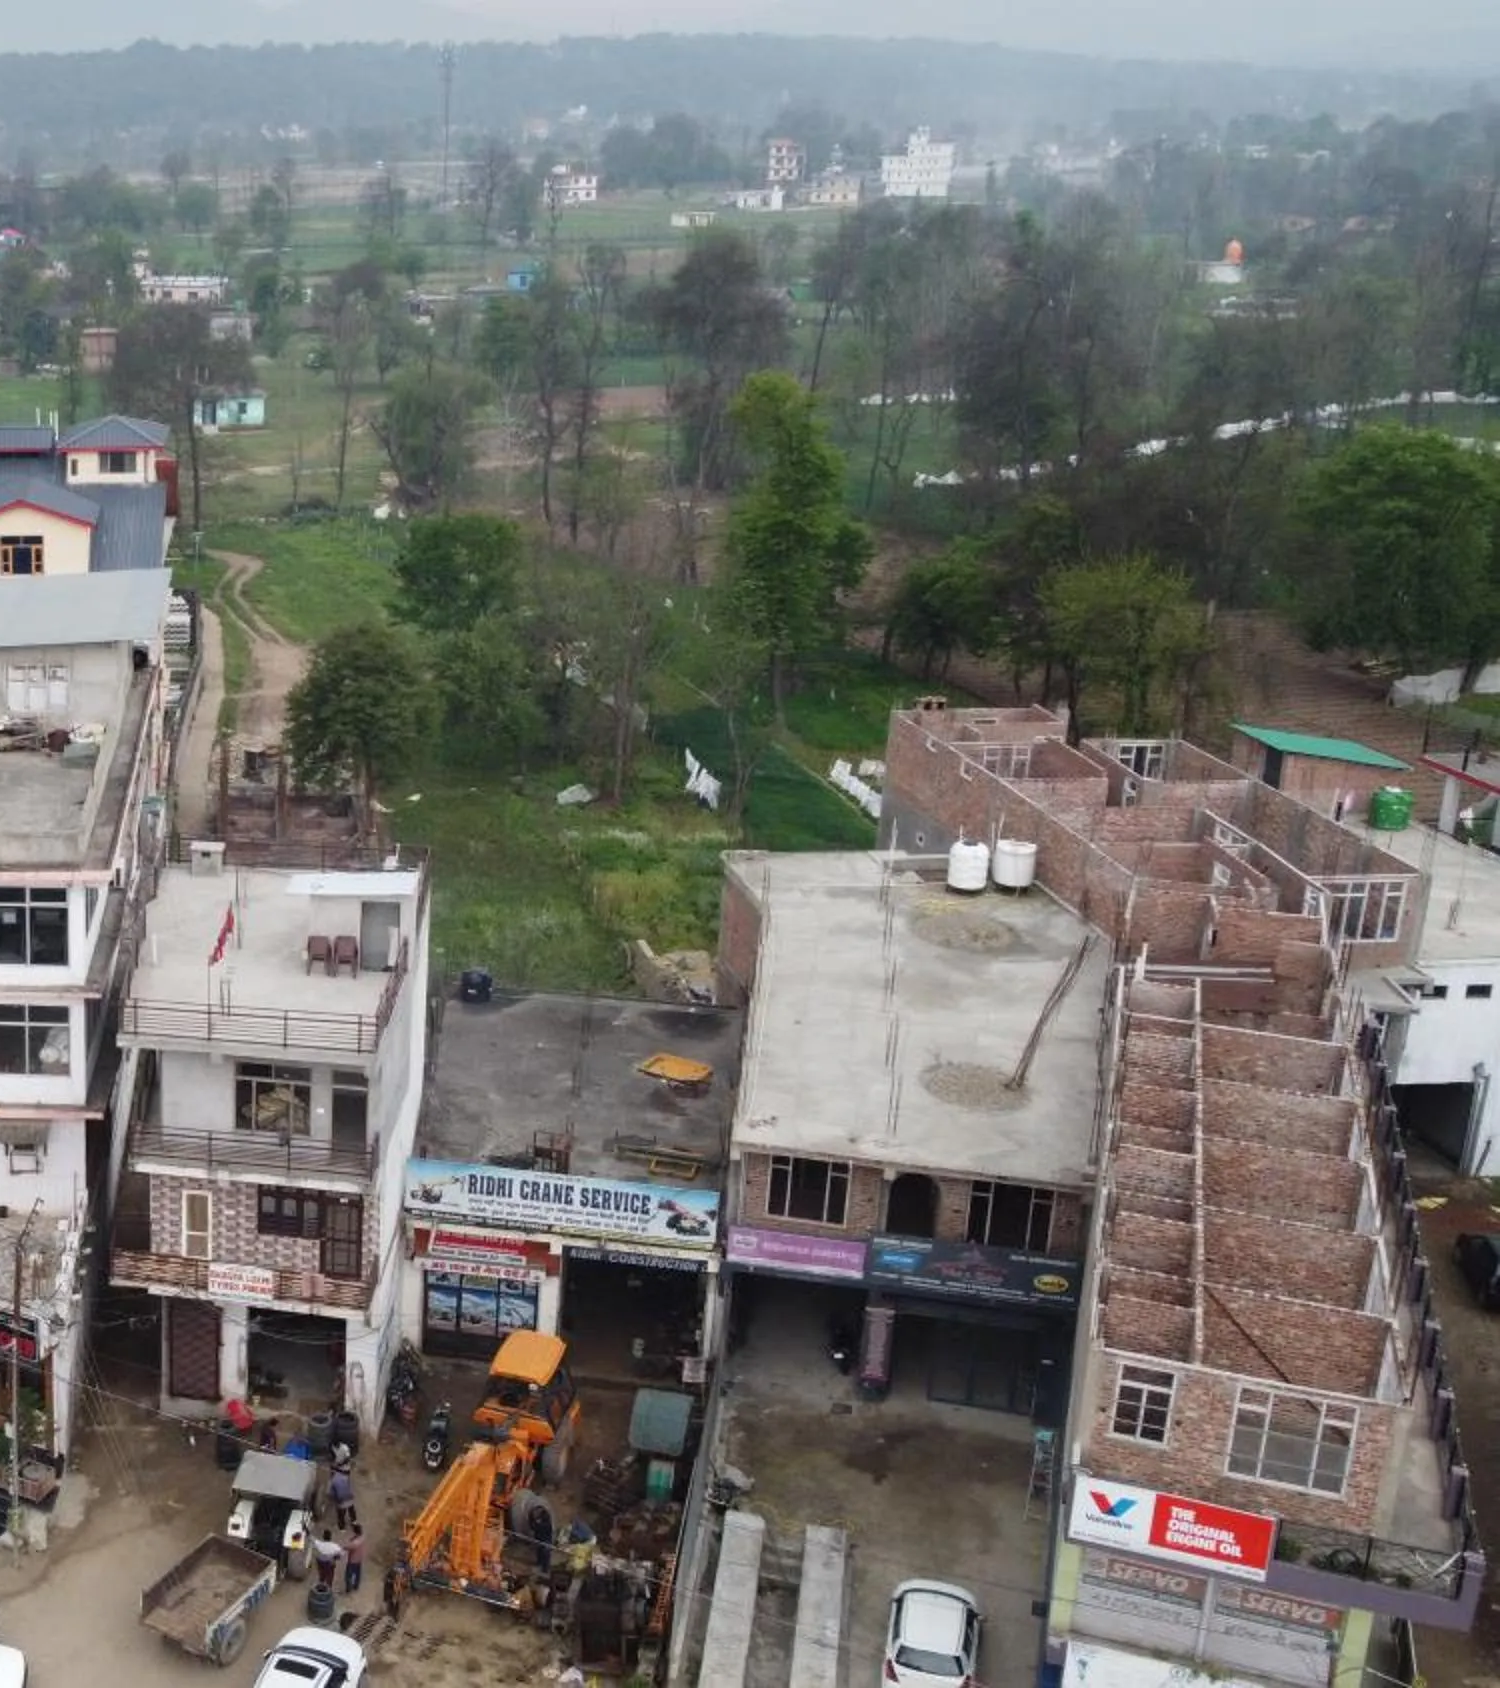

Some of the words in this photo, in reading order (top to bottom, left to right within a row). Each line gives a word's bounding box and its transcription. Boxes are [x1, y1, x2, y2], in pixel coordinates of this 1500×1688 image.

[467, 1173, 513, 1198] RIDHI
[519, 1179, 574, 1205] CRANE
[579, 1187, 652, 1215] SERVICE
[1170, 1506, 1197, 1522] THE
[1165, 1531, 1217, 1554] ENGINE
[1219, 1543, 1243, 1558] OIL
[1167, 1519, 1237, 1544] ORIGINAL
[1110, 1561, 1190, 1593] SERVO
[1247, 1593, 1326, 1624] SERVO
